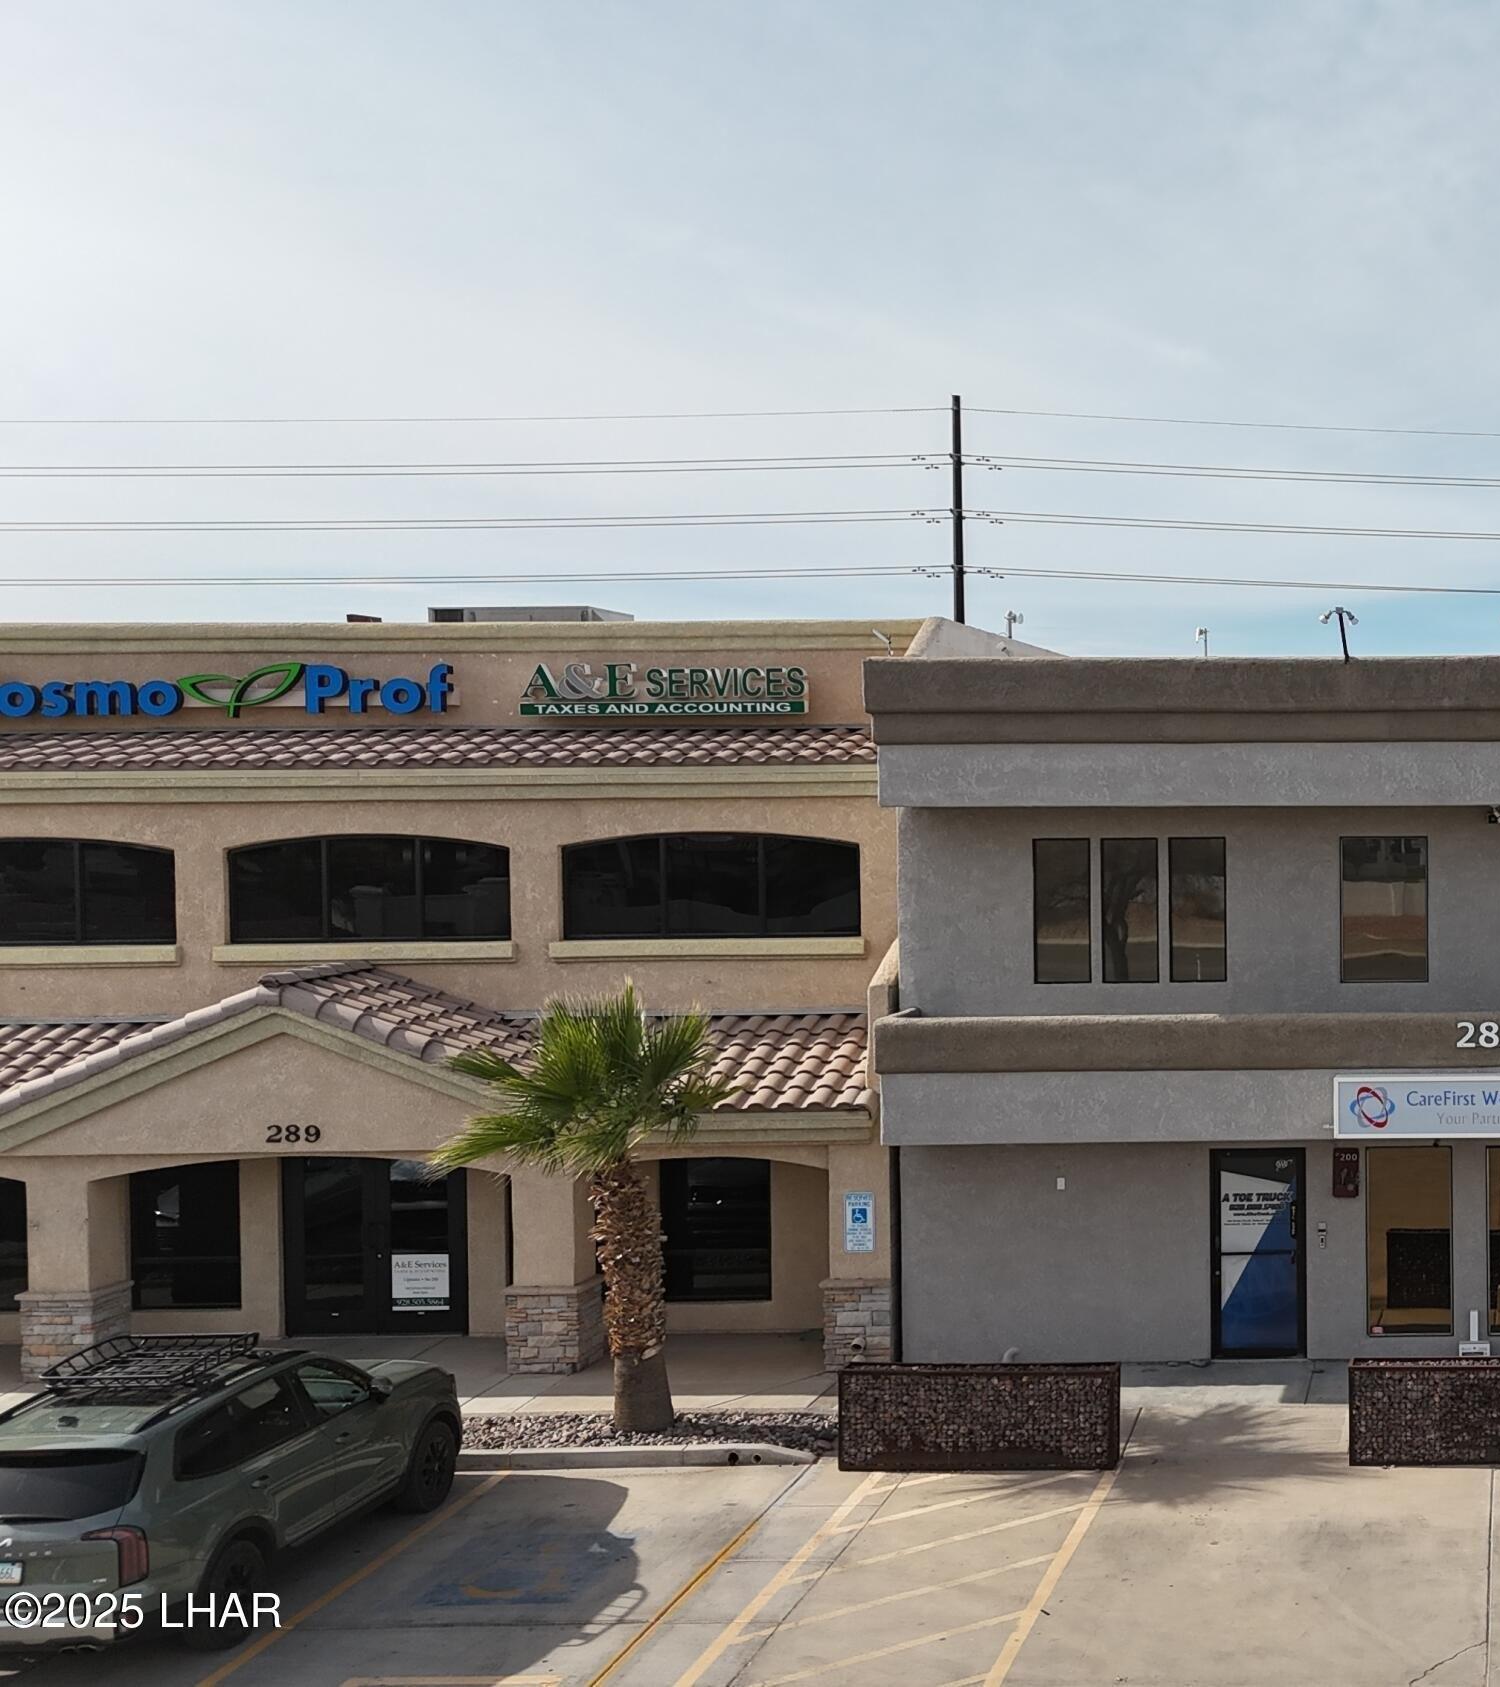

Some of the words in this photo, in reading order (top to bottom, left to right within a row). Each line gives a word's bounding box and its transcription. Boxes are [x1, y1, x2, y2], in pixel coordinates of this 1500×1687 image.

[304, 663, 450, 714] Prof
[520, 663, 637, 699] A&E
[646, 667, 806, 697] SERVICES
[534, 703, 600, 715] TAXES
[603, 703, 649, 714] AND
[654, 702, 792, 714] ACCOUNTING
[1406, 1090, 1476, 1106] CareFirst
[1437, 1113, 1466, 1125] Your
[265, 1124, 321, 1143] 289
